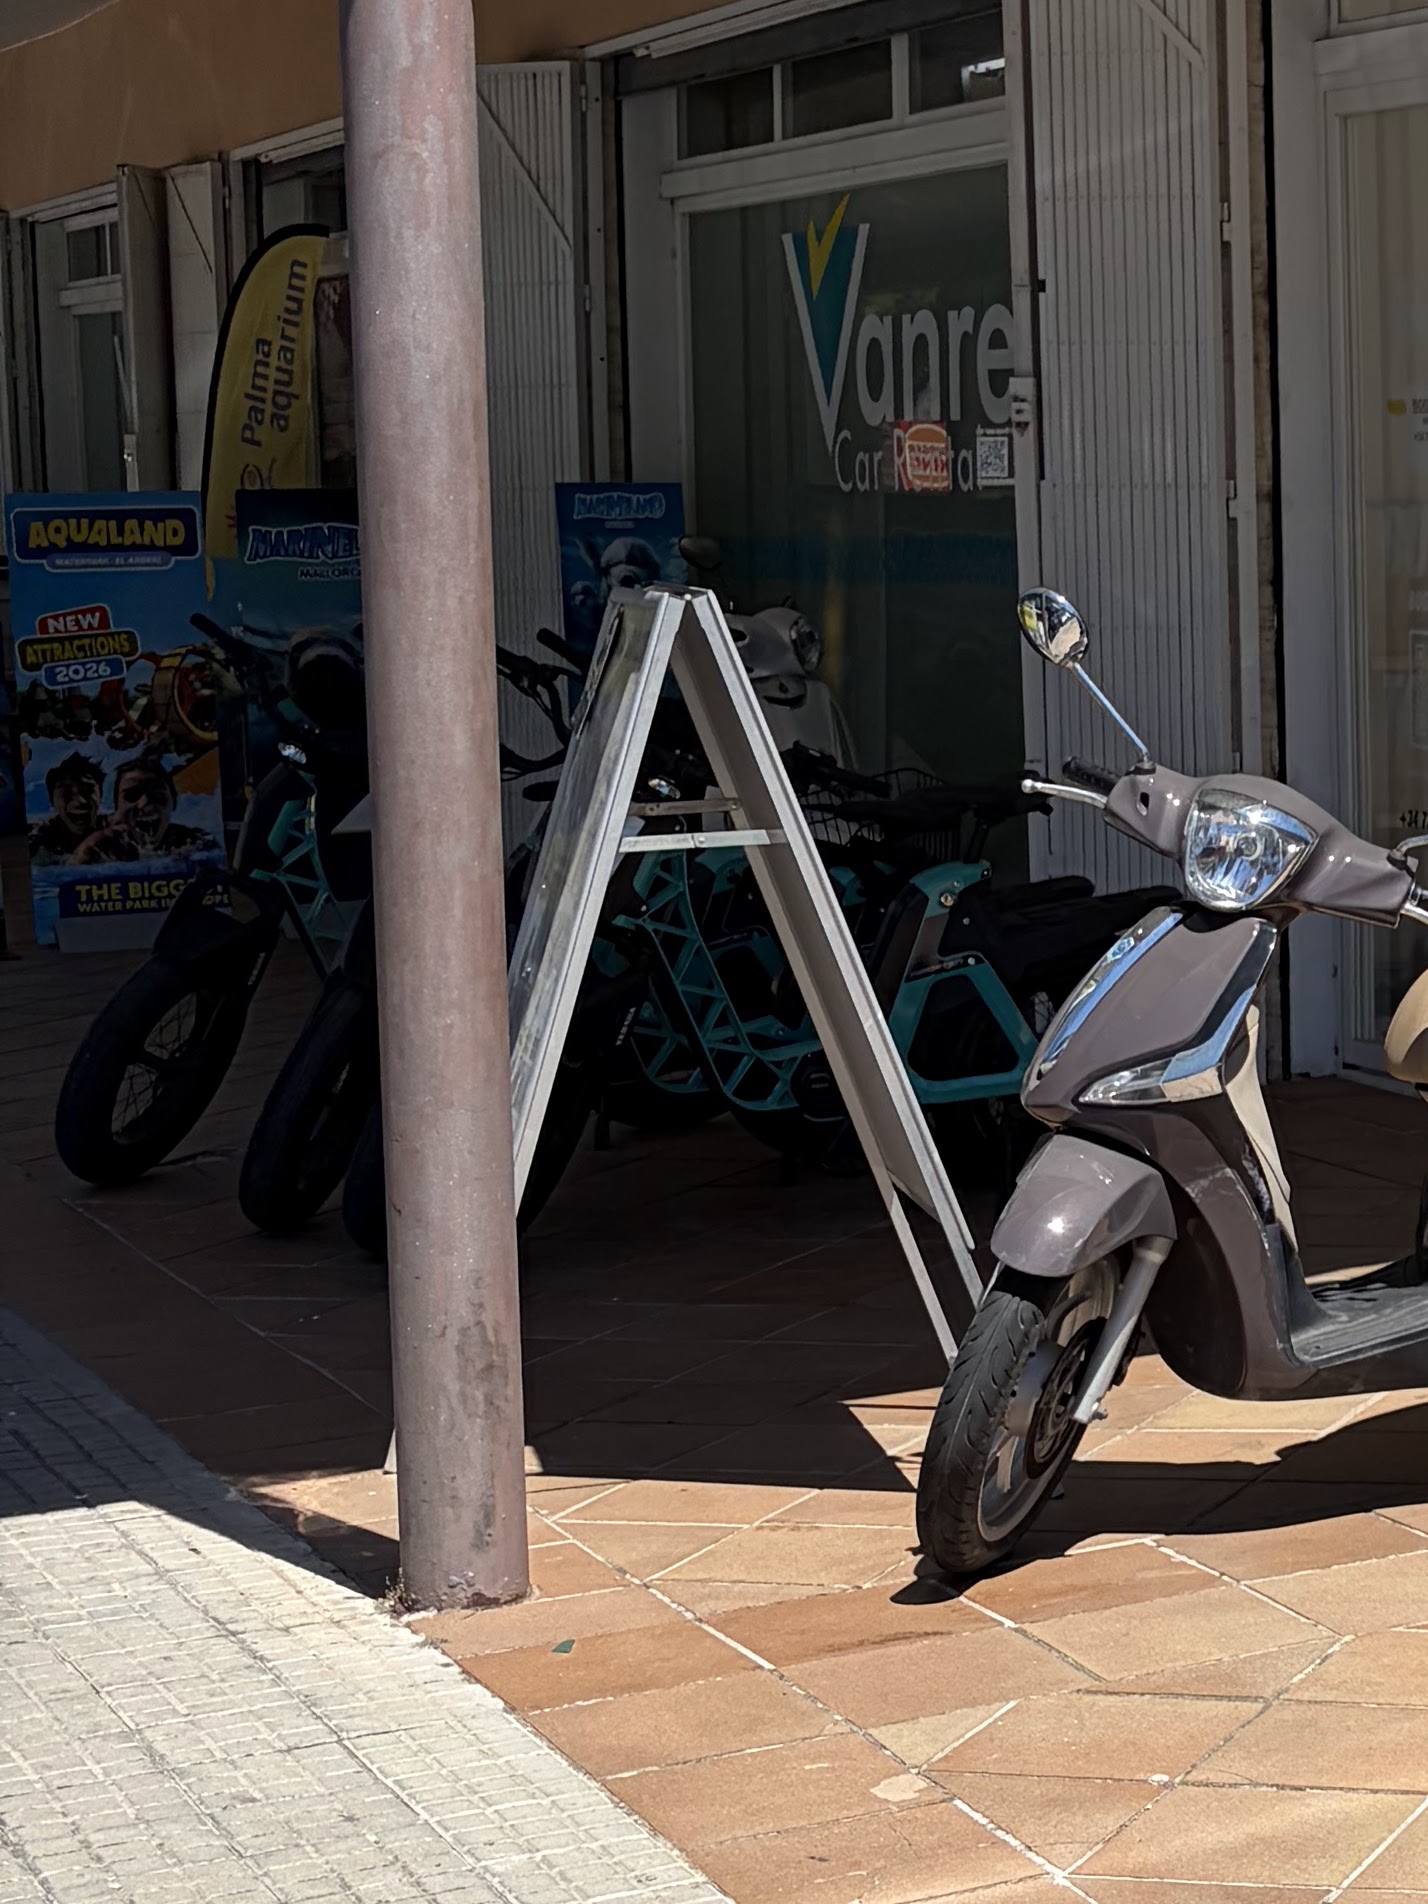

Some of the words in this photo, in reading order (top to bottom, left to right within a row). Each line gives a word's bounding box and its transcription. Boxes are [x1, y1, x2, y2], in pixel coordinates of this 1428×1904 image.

[270, 258, 309, 433] aquarium
[241, 337, 273, 448] Palma
[834, 428, 883, 493] Car
[27, 517, 187, 550] AQUALAND
[46, 611, 101, 634] NEW
[25, 632, 131, 665] ATTRACTIONS
[55, 660, 112, 683] 2026
[74, 882, 122, 901] THE
[77, 900, 121, 913] WATER
